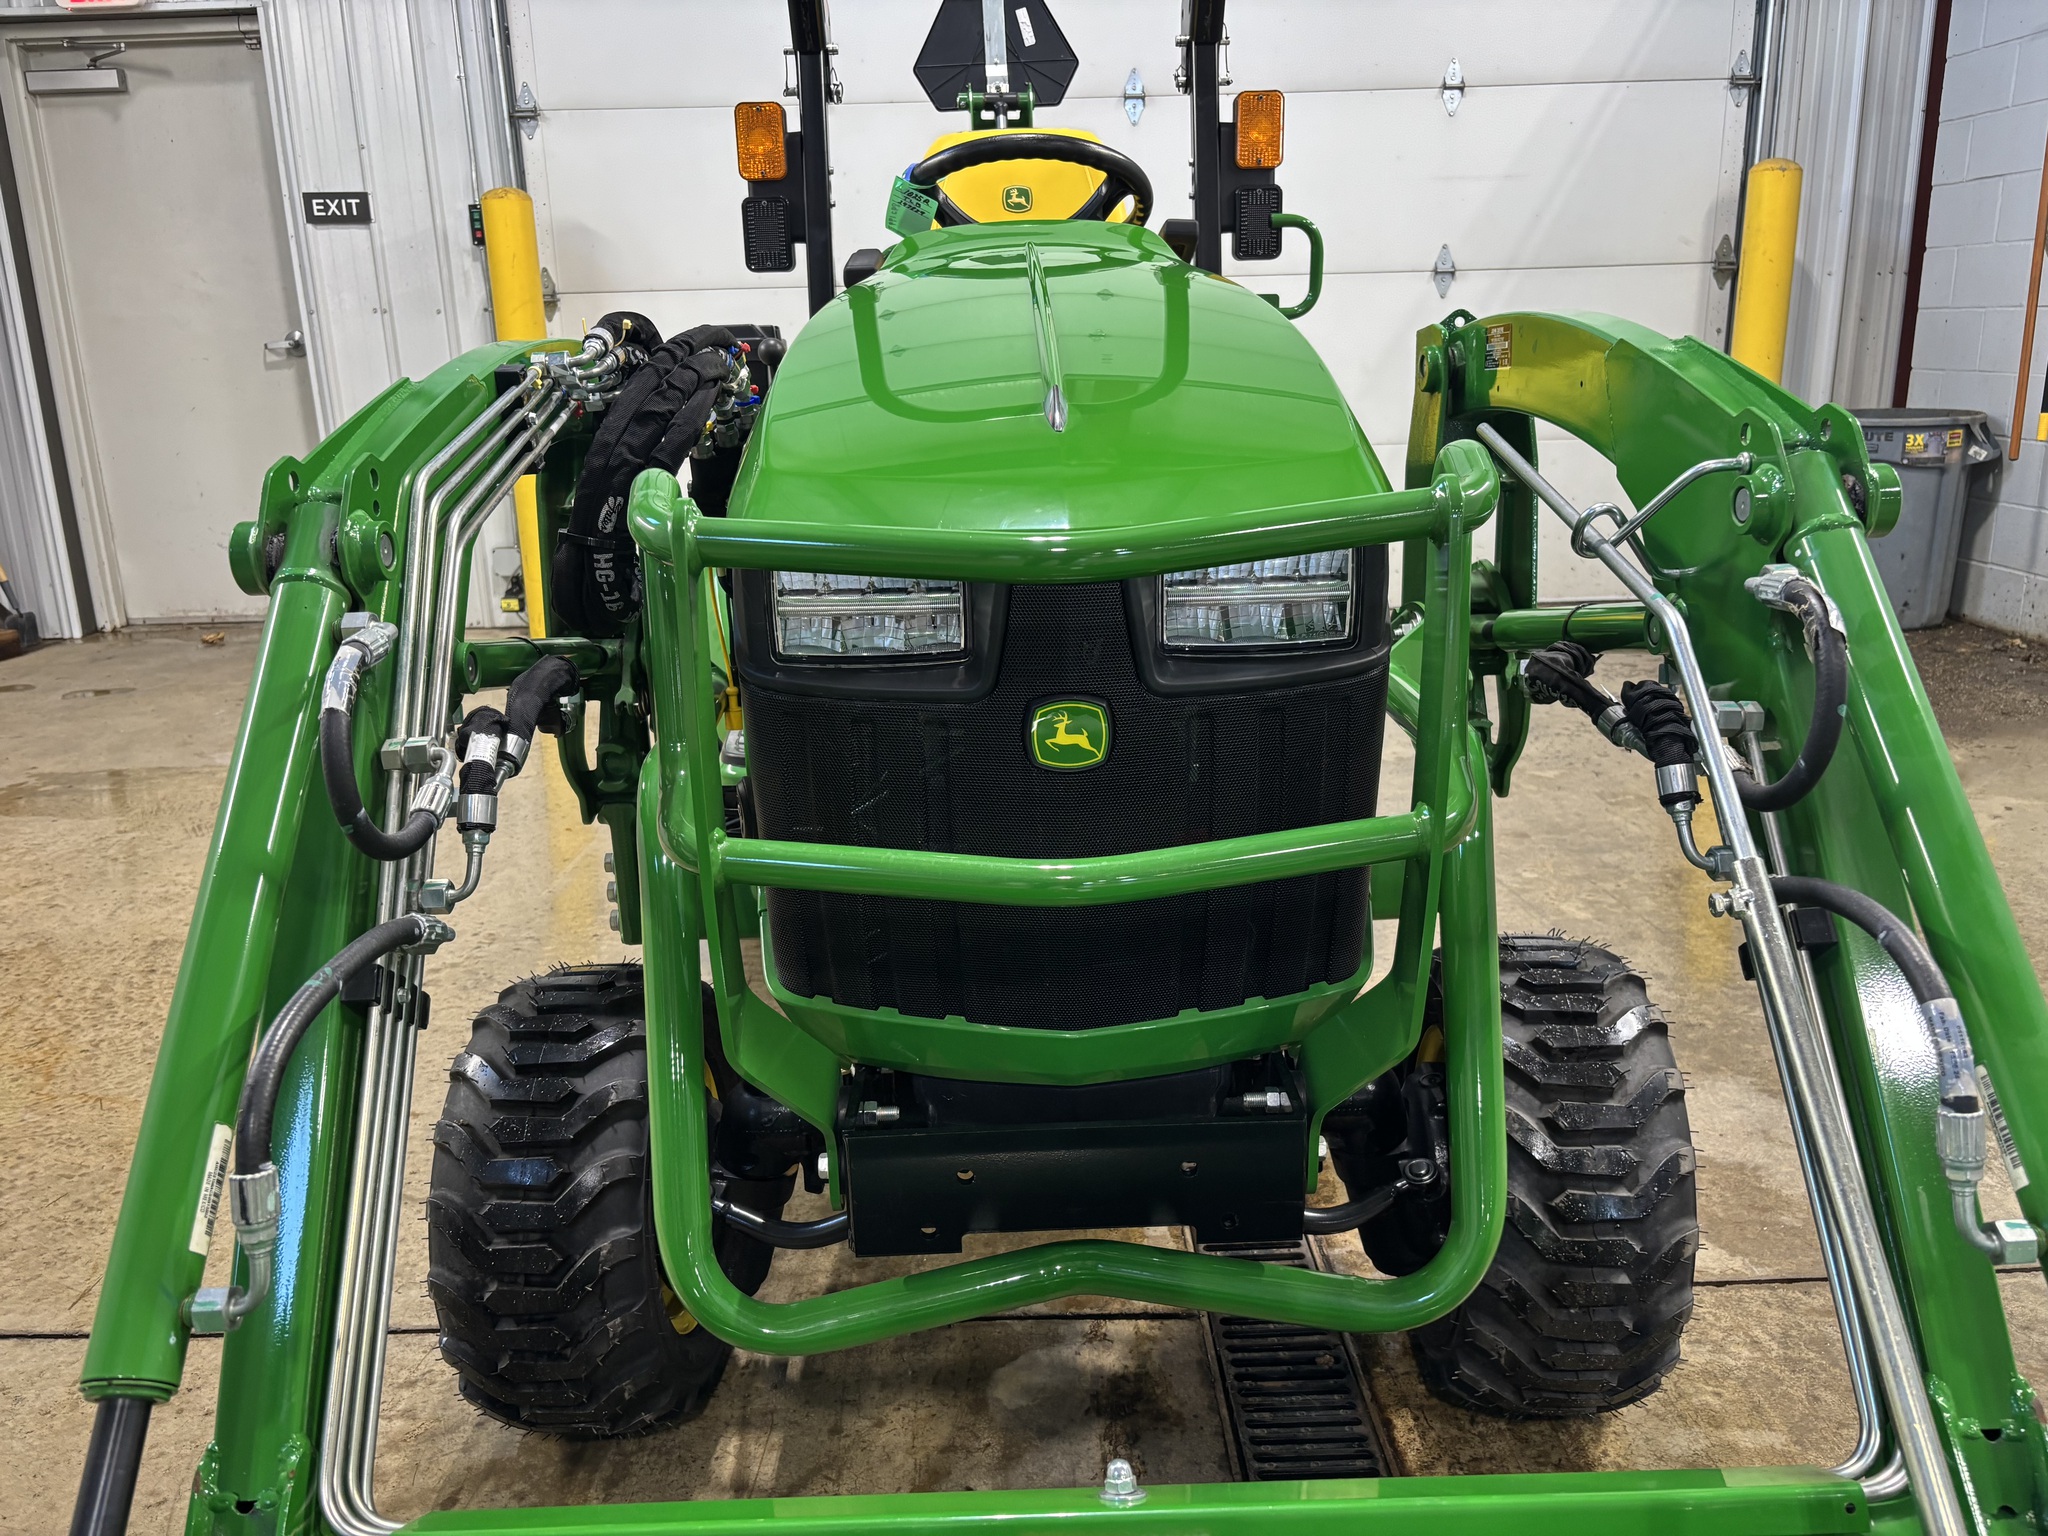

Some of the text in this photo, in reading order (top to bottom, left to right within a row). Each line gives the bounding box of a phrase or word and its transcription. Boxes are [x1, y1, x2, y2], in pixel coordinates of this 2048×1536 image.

[311, 198, 361, 217] EXIT
[1864, 431, 1894, 442] UTE
[1905, 434, 1925, 447] 3X
[593, 553, 625, 612] HG-16
